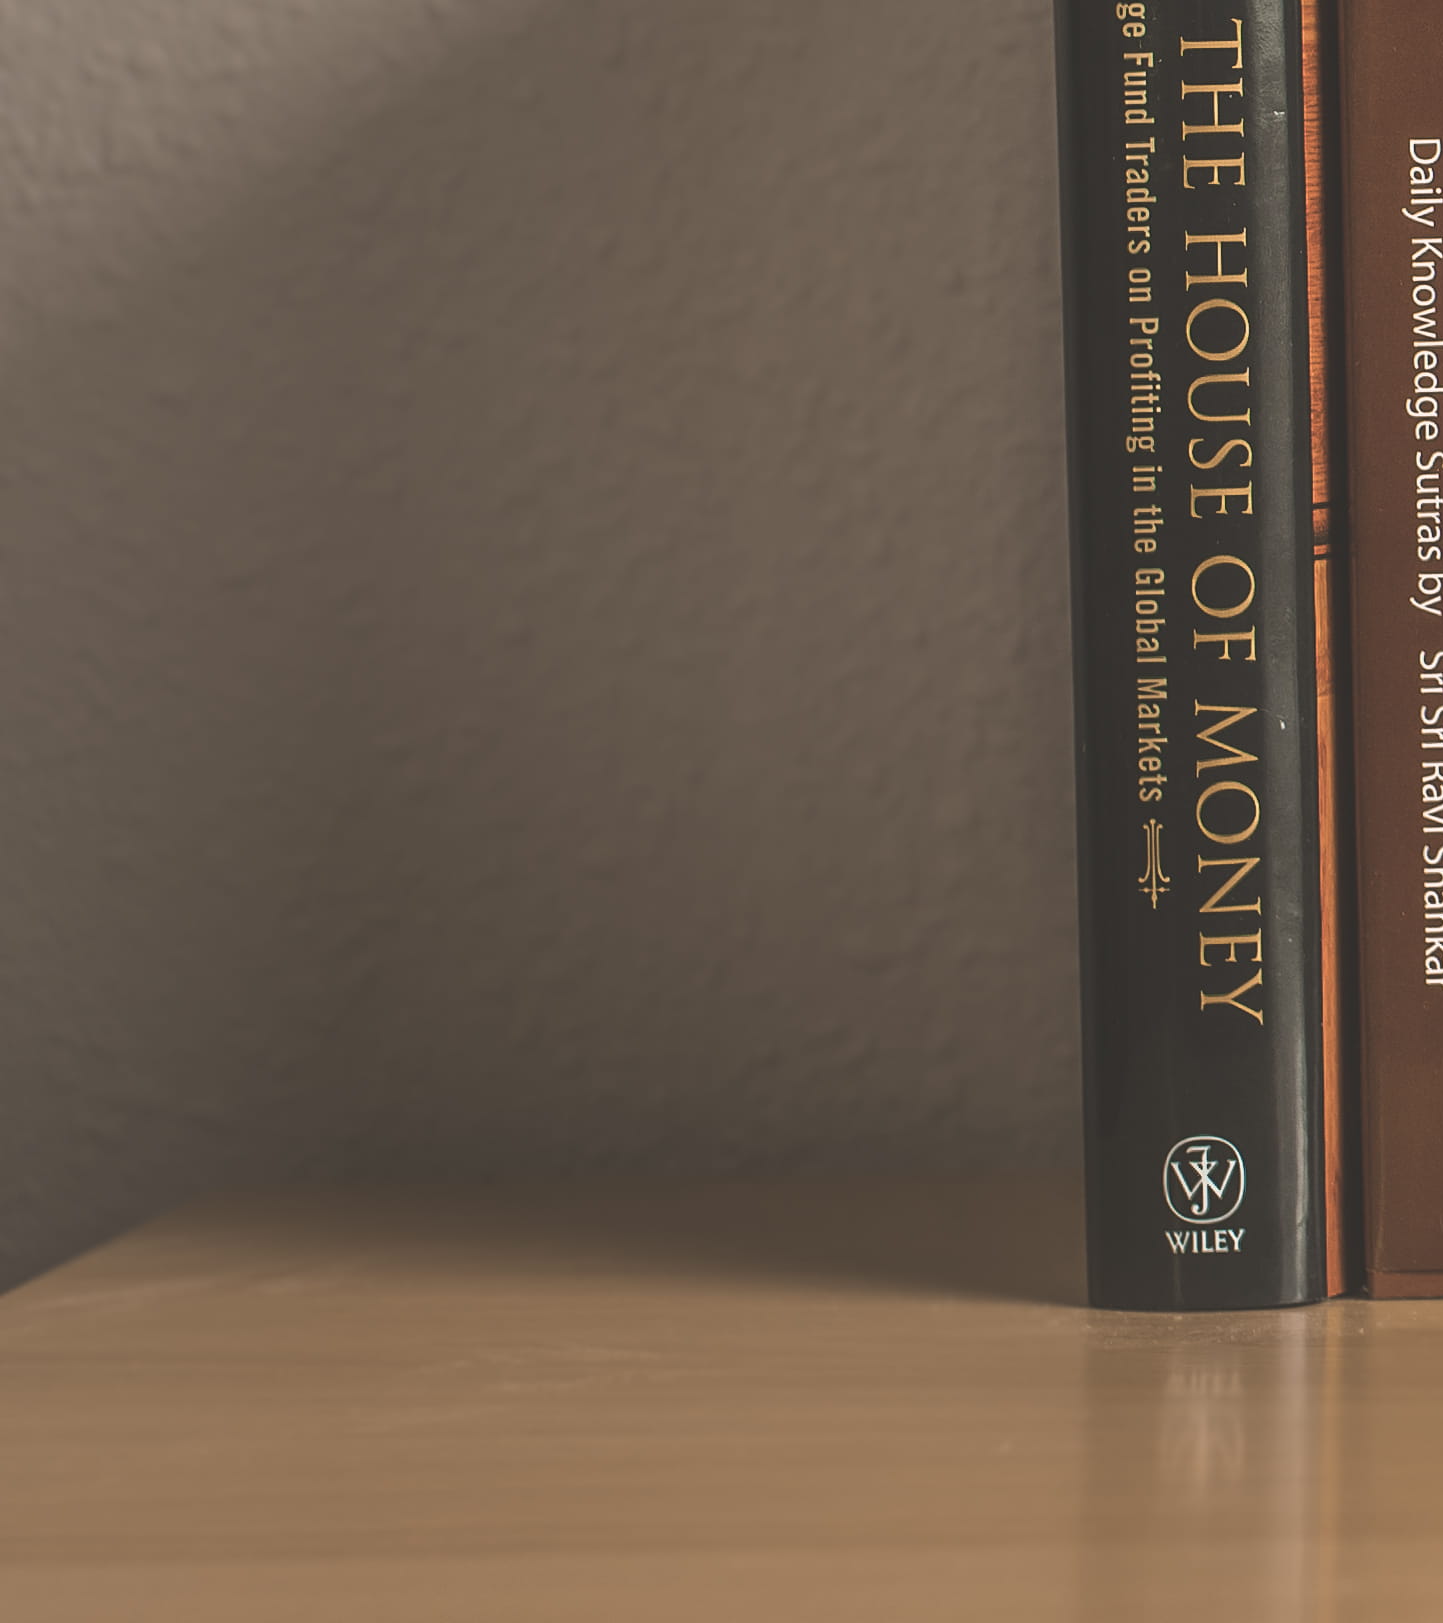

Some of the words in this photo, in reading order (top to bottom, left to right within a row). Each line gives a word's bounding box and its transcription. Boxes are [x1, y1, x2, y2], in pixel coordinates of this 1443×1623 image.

[1122, 51, 1156, 125] Fund
[1179, 17, 1247, 190] THE
[1124, 135, 1158, 255] Traders
[1400, 137, 1443, 228] Daily
[1127, 267, 1153, 303] on
[1125, 316, 1163, 454] Profiting
[1183, 226, 1254, 520] HOUSE
[1131, 464, 1164, 493] in
[1132, 503, 1165, 554] the
[1134, 567, 1167, 664] Global
[1190, 554, 1258, 662] OF
[1136, 677, 1169, 803] Markets
[1193, 698, 1265, 1027] MONEY
[1164, 1227, 1246, 1254] WILEY
